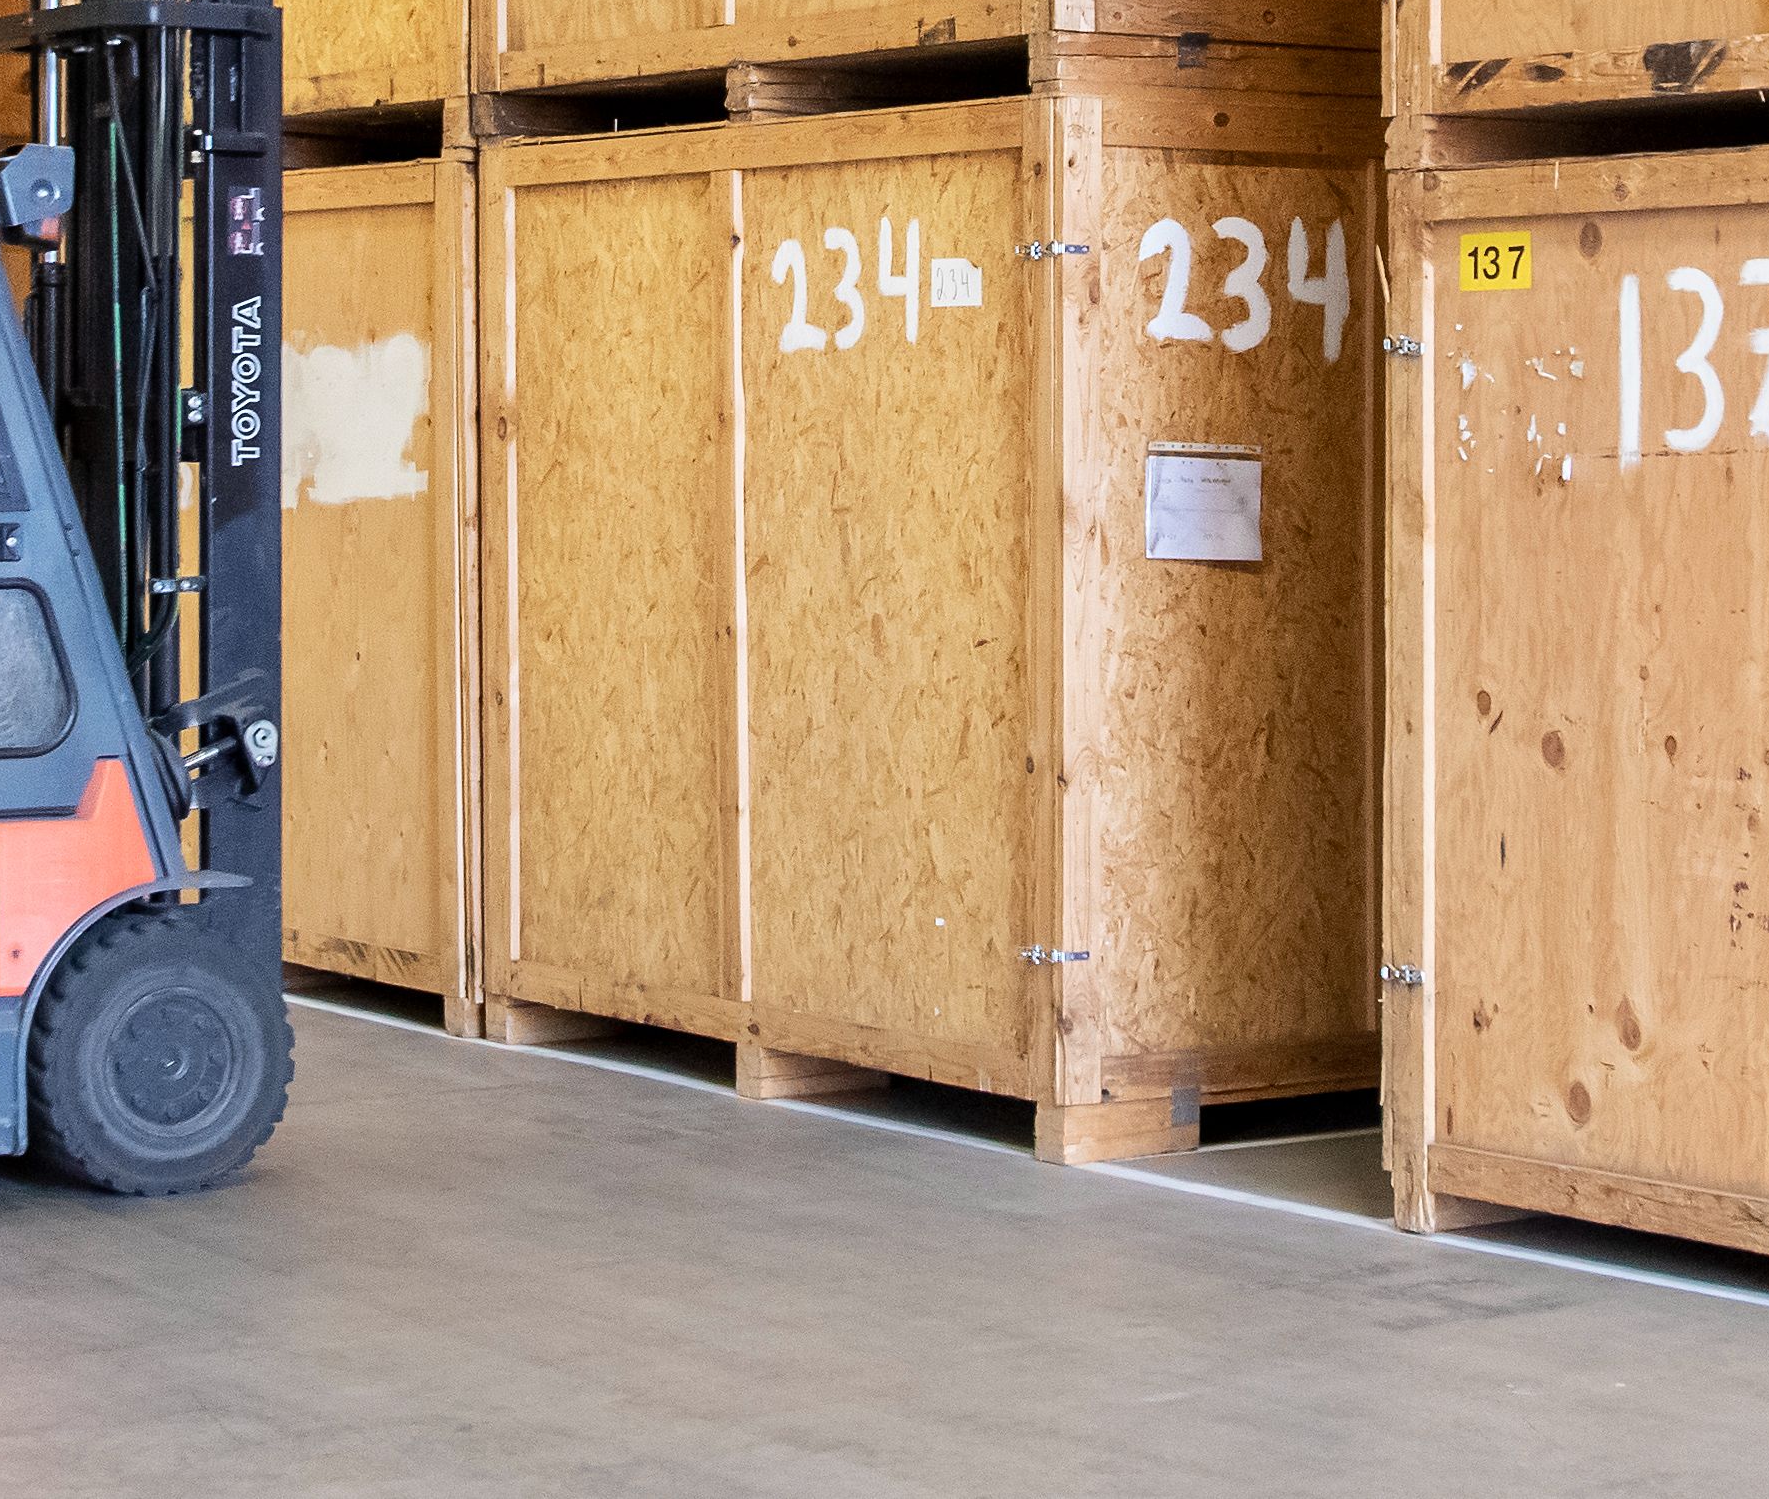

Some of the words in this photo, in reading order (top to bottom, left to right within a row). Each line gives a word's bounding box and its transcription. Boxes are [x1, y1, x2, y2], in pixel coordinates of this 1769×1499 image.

[770, 216, 921, 354] 234
[935, 267, 970, 301] 234
[1138, 215, 1351, 363] 234
[1467, 245, 1525, 282] 137
[231, 295, 262, 467] TOYOTA
